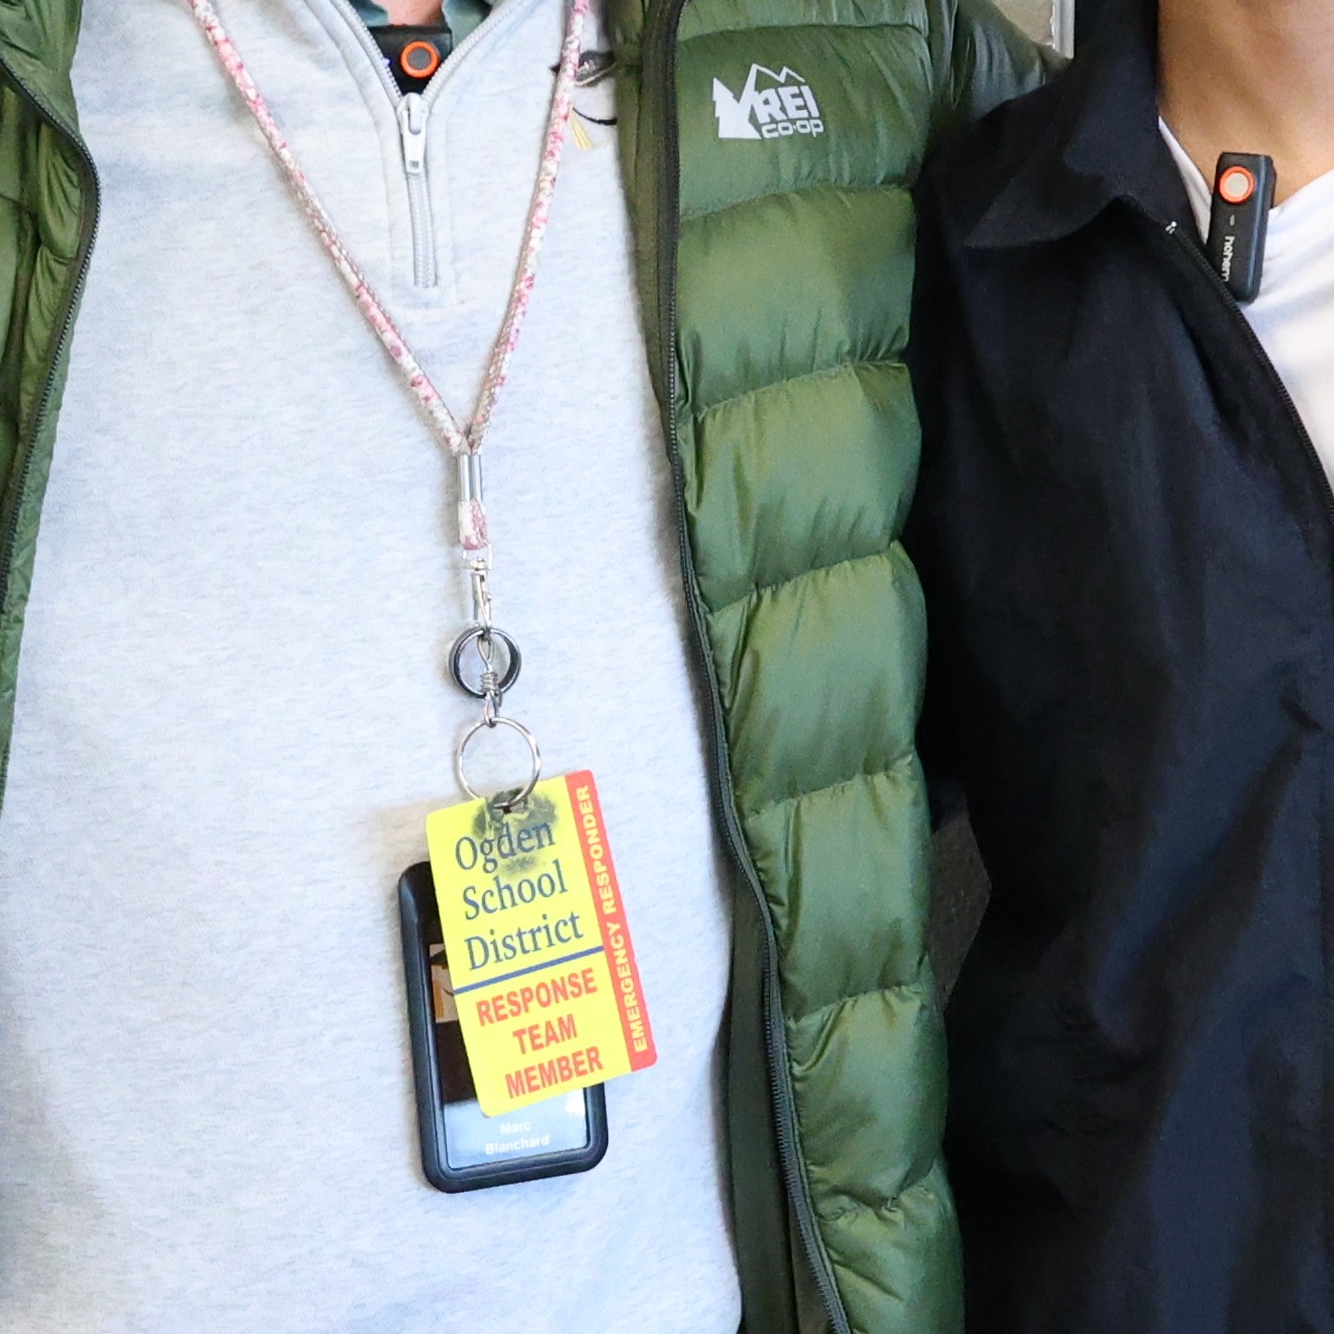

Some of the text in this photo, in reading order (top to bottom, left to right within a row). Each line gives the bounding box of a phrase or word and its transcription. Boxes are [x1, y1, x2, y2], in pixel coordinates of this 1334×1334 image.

[753, 84, 821, 124] REI
[455, 820, 556, 874] Ogden
[463, 858, 569, 920] School
[464, 911, 584, 971] District
[576, 784, 648, 1052] EMERGENCY RESPONDER
[476, 967, 598, 1027] RESPONSE
[512, 1013, 578, 1055] TEAM
[504, 1046, 604, 1099] MEMBER
[484, 1133, 551, 1156] Blanchard
[499, 1120, 533, 1136] Marc
